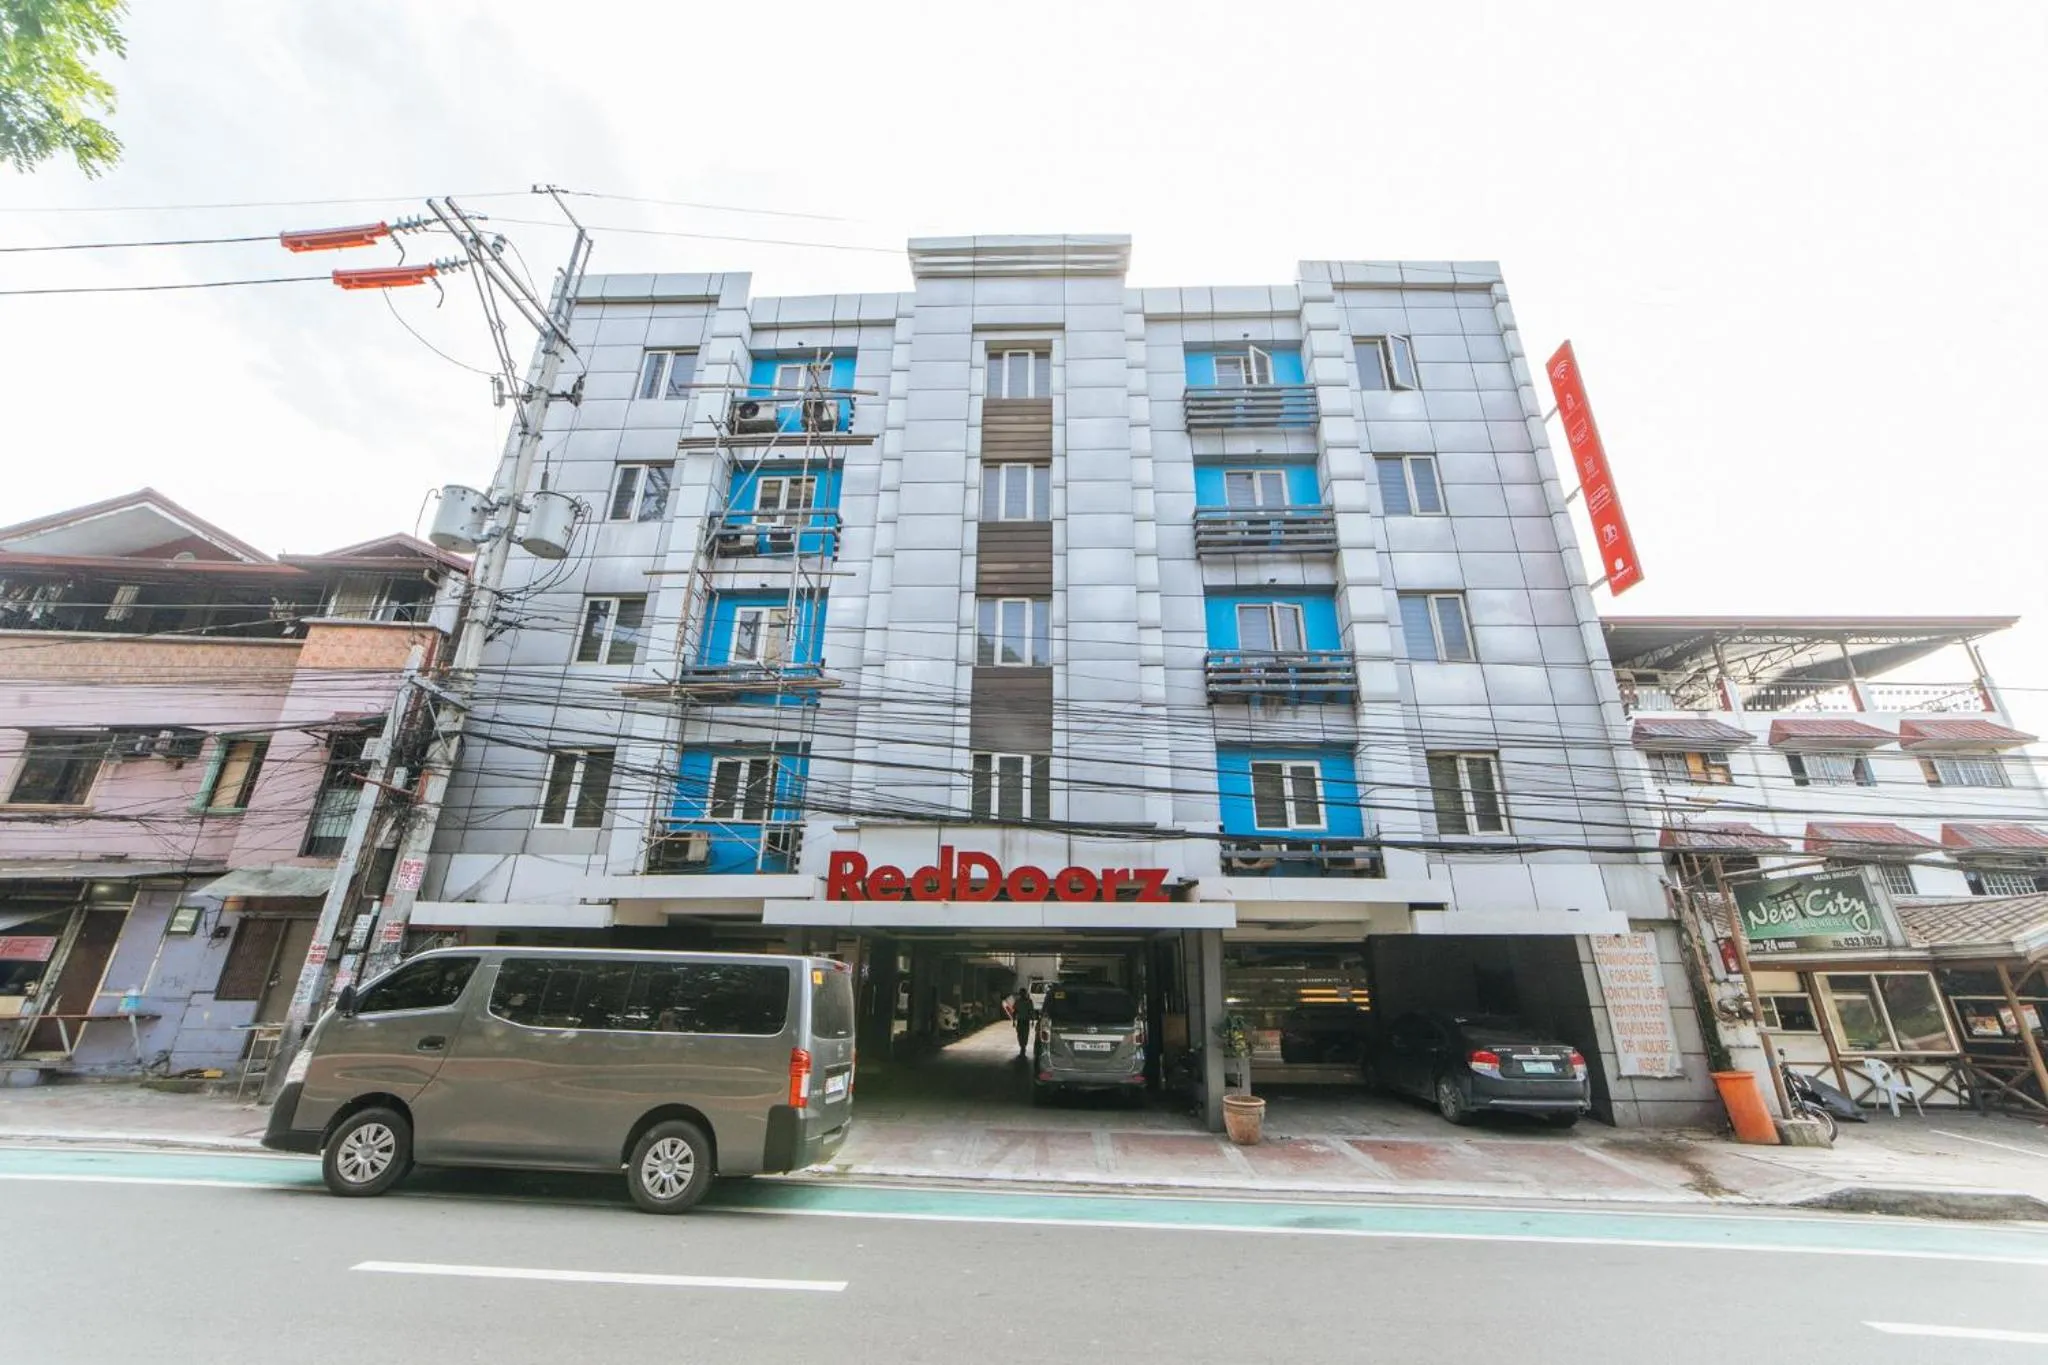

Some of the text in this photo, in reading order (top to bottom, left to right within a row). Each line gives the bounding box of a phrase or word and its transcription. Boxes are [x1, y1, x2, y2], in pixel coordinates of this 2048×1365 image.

[827, 845, 1170, 902] RedDoorz
[1747, 901, 1798, 931] New
[1804, 888, 1871, 934] City
[1596, 935, 1647, 949] BRAND NEW
[1763, 939, 1778, 952] 24
[1609, 969, 1652, 983] FOR SALE
